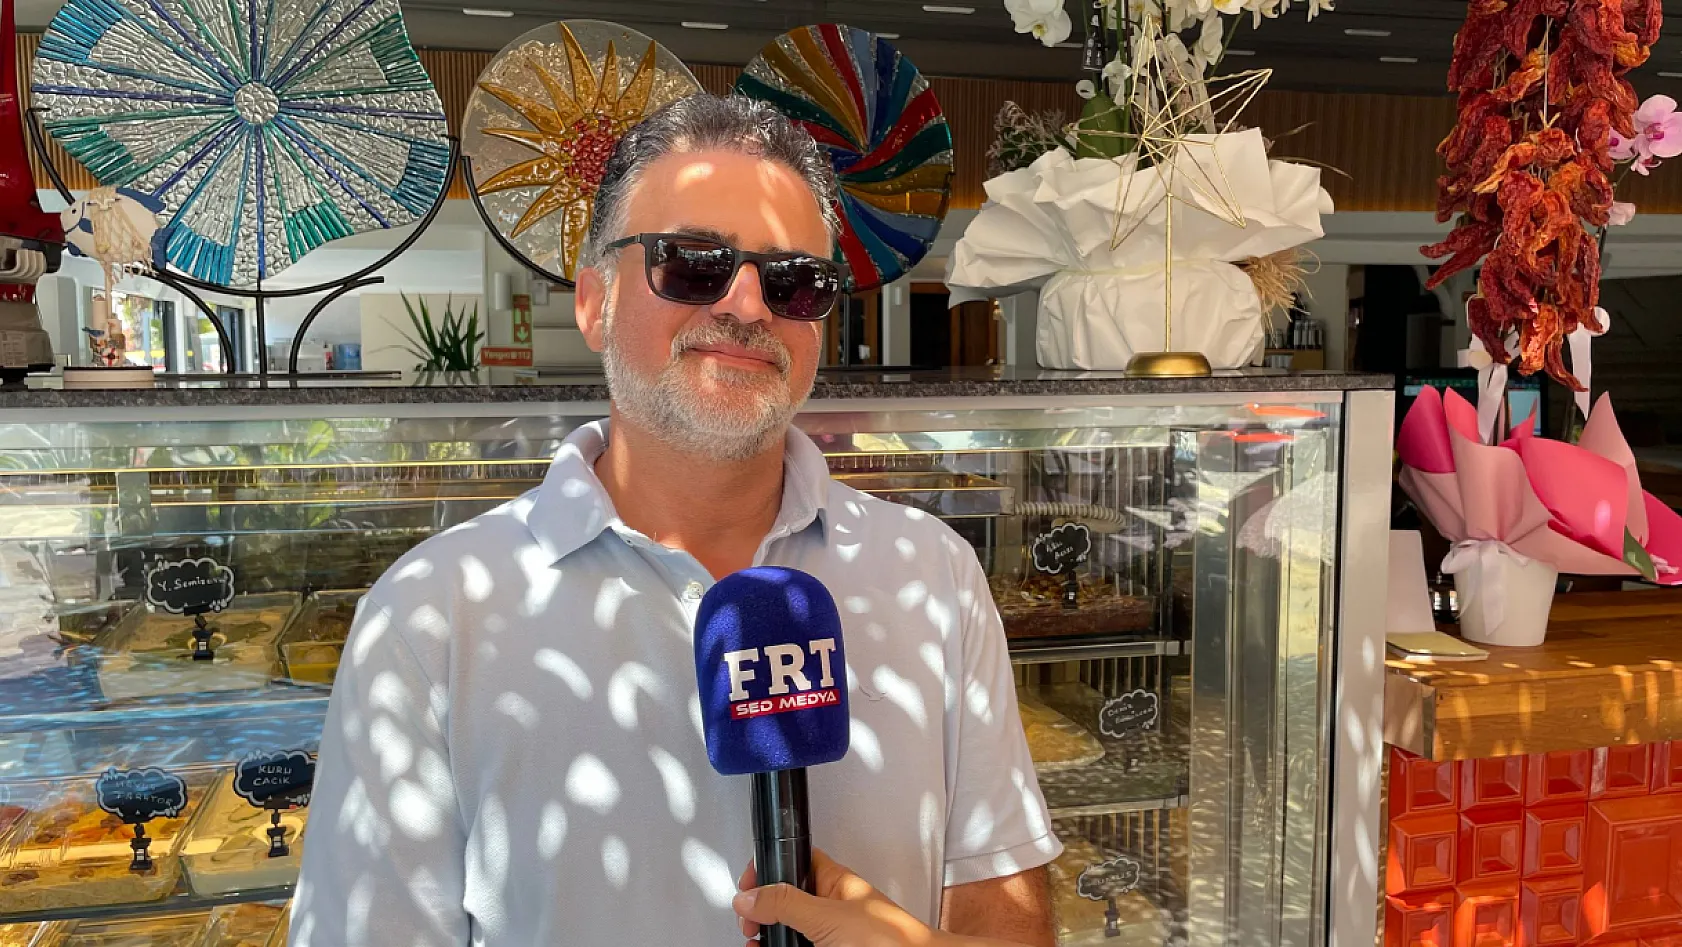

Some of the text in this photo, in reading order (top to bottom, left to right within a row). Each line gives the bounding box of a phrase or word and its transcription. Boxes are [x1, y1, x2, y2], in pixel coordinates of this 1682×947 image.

[724, 637, 837, 702] FRT
[735, 691, 838, 716] SED MEDYA
[258, 765, 293, 775] KURU
